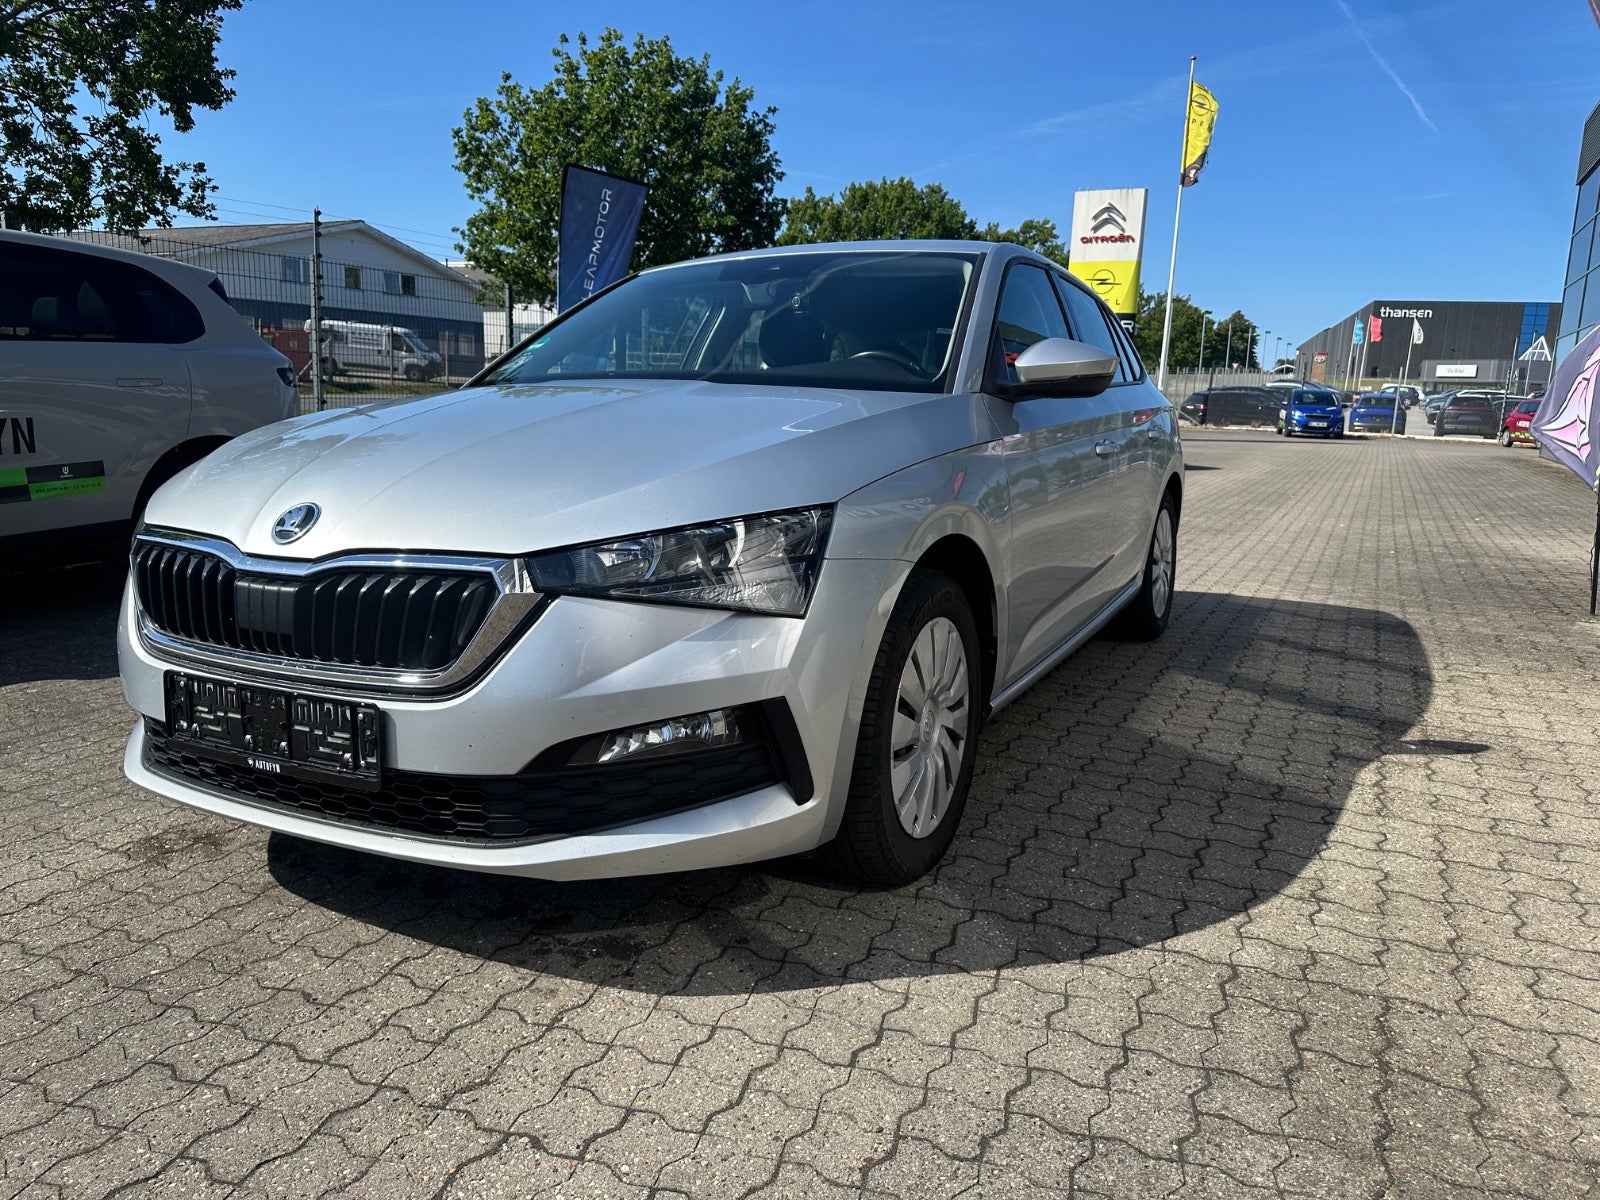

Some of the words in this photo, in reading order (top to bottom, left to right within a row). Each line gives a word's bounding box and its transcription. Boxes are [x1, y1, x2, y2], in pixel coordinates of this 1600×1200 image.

[581, 188, 612, 300] LEAPMOTOR
[1379, 306, 1433, 318] thansen
[255, 759, 281, 773] AUTOFYN
